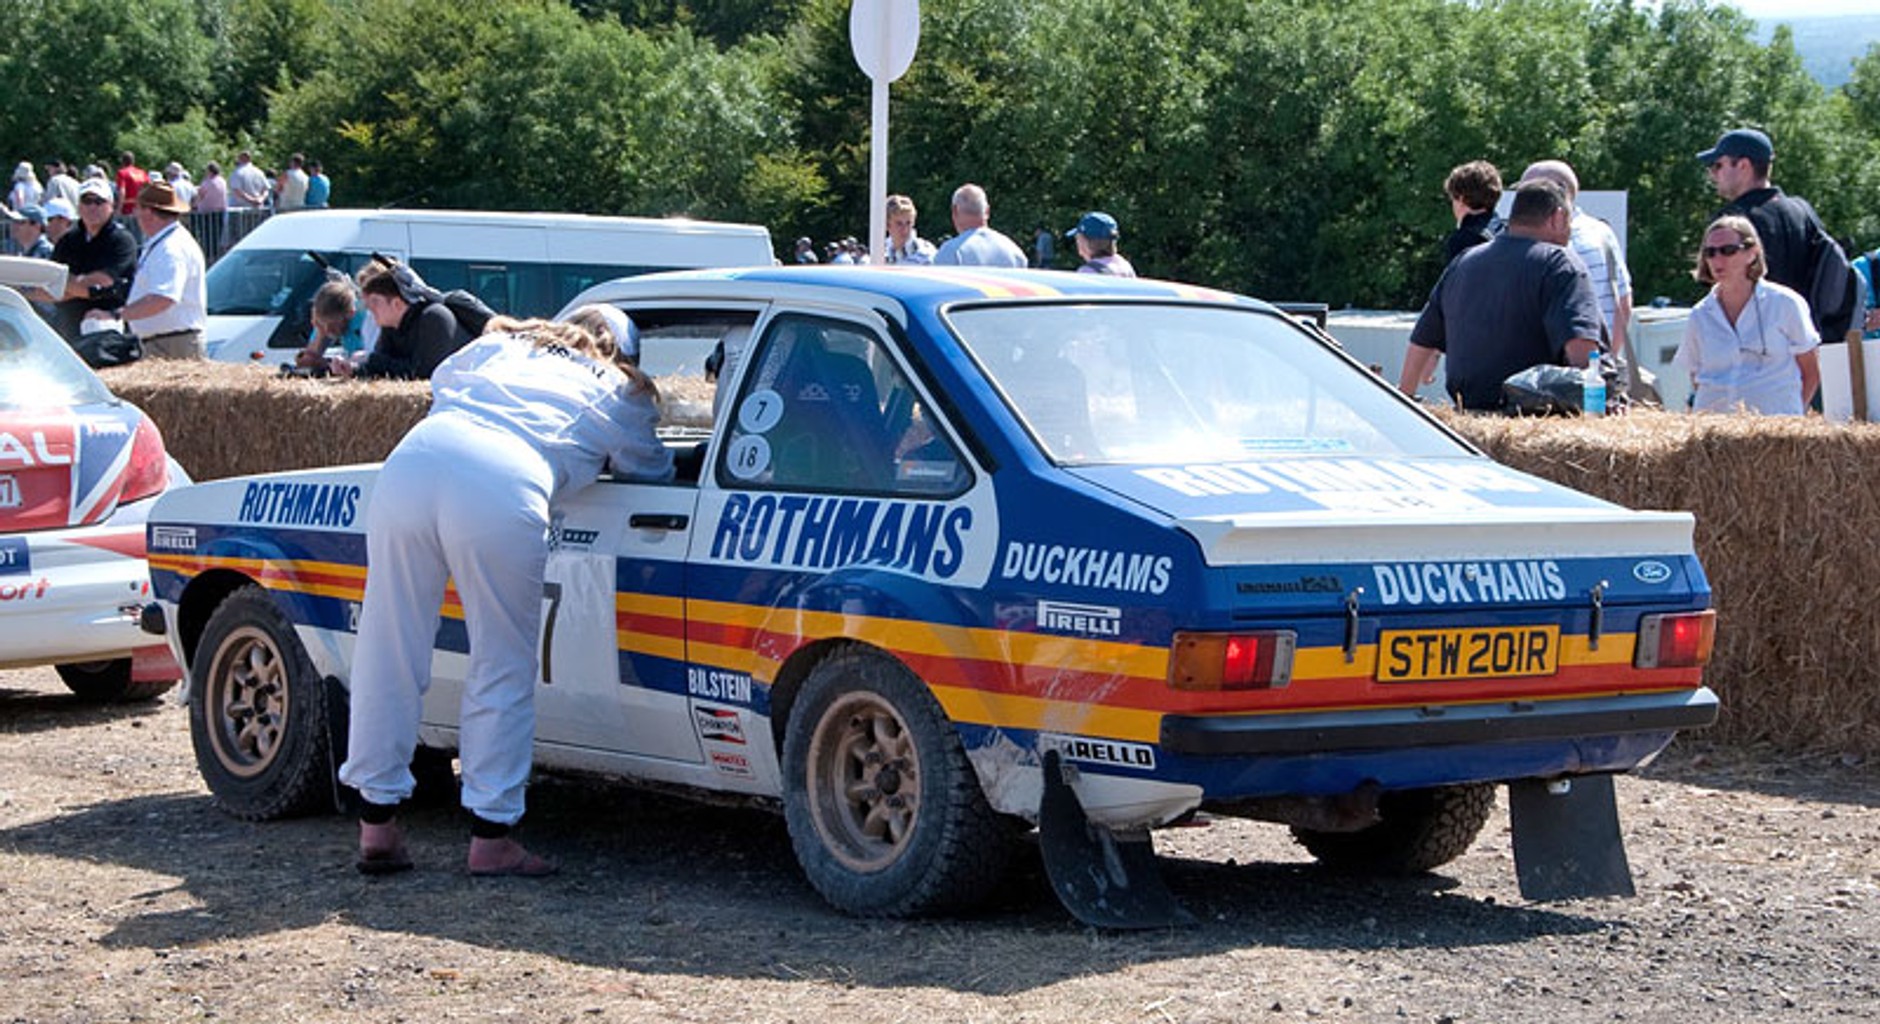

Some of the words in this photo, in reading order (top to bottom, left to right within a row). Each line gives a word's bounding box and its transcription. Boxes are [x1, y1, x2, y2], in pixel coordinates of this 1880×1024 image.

[754, 400, 768, 422] 7
[738, 446, 758, 468] 18
[239, 482, 360, 527] ROTHMANS
[710, 493, 972, 578] ROTHMANS
[1001, 541, 1173, 595] DUCKHAMS
[1373, 561, 1567, 605] DUCKHAMS
[1036, 600, 1121, 635] PIRELLI
[1388, 632, 1467, 677] STW
[1468, 628, 1549, 674] 201R
[688, 668, 752, 703] BILSTEIN
